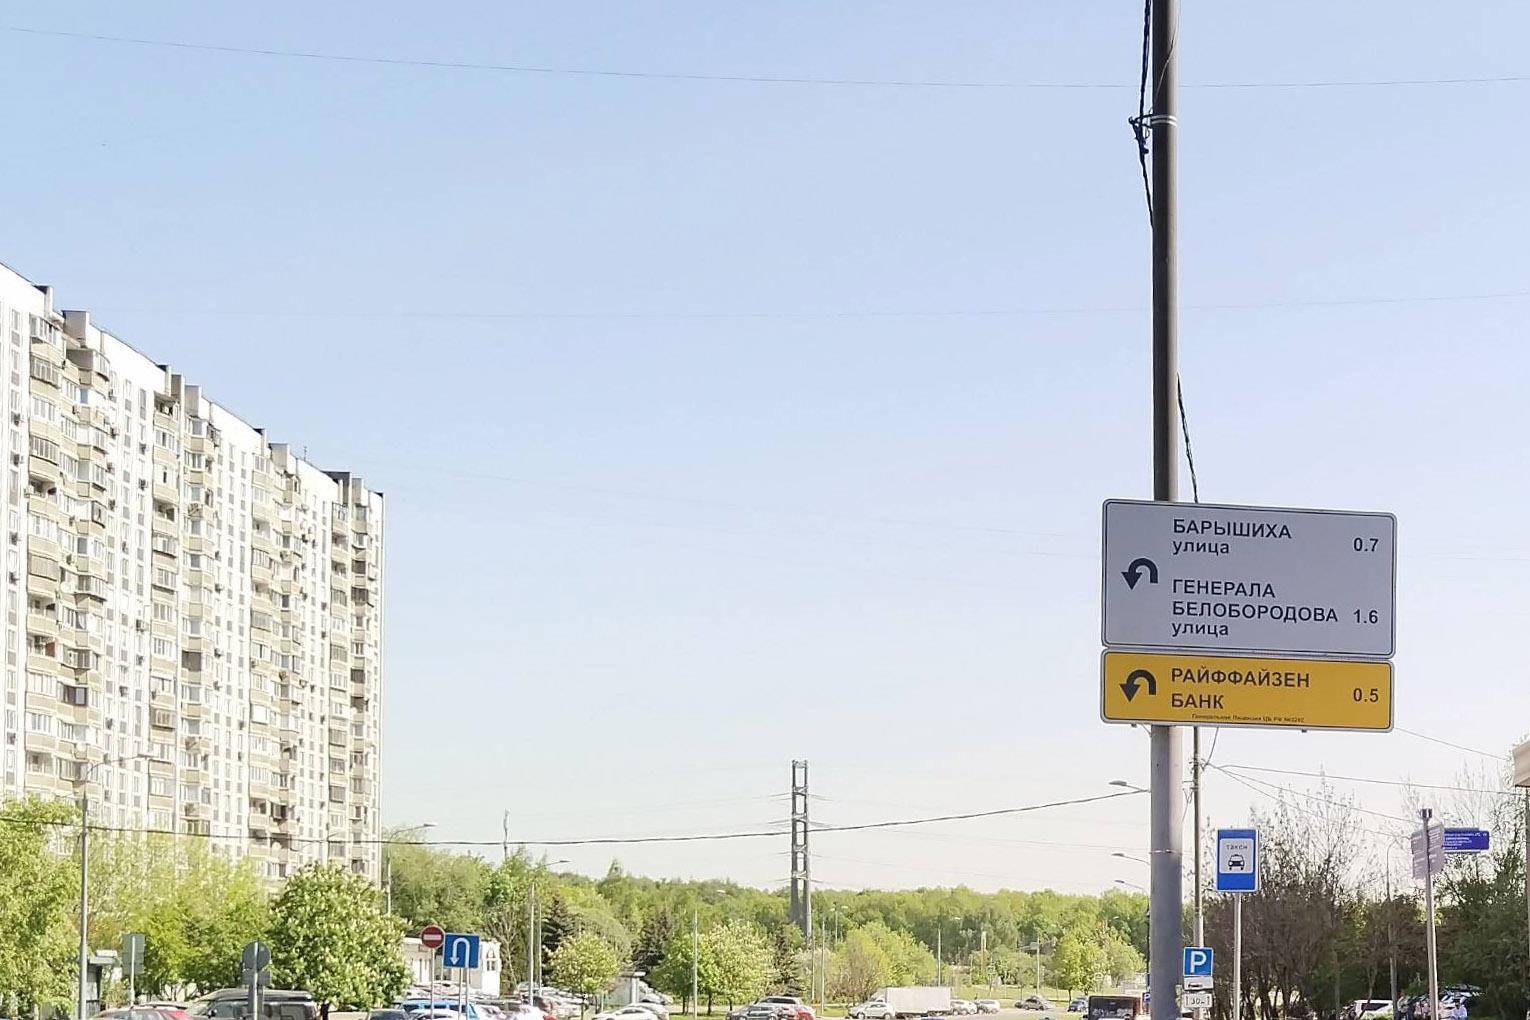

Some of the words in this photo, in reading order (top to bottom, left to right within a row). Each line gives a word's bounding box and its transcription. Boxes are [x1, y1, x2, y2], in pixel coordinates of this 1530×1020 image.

[1173, 518, 1292, 539] БАРЫШИХА
[1173, 541, 1229, 555] улица
[1353, 537, 1379, 552] 0.7
[1172, 579, 1276, 598] ГЕНЕРАЛА
[1172, 601, 1338, 623] БЕЛОБОРОДОВА
[1353, 609, 1379, 624] 1.6
[1171, 624, 1229, 638] улица
[1171, 665, 1310, 688] РАЙФФАЙЗЕН
[1171, 693, 1224, 710] БАНК
[1353, 688, 1379, 703] 0.5
